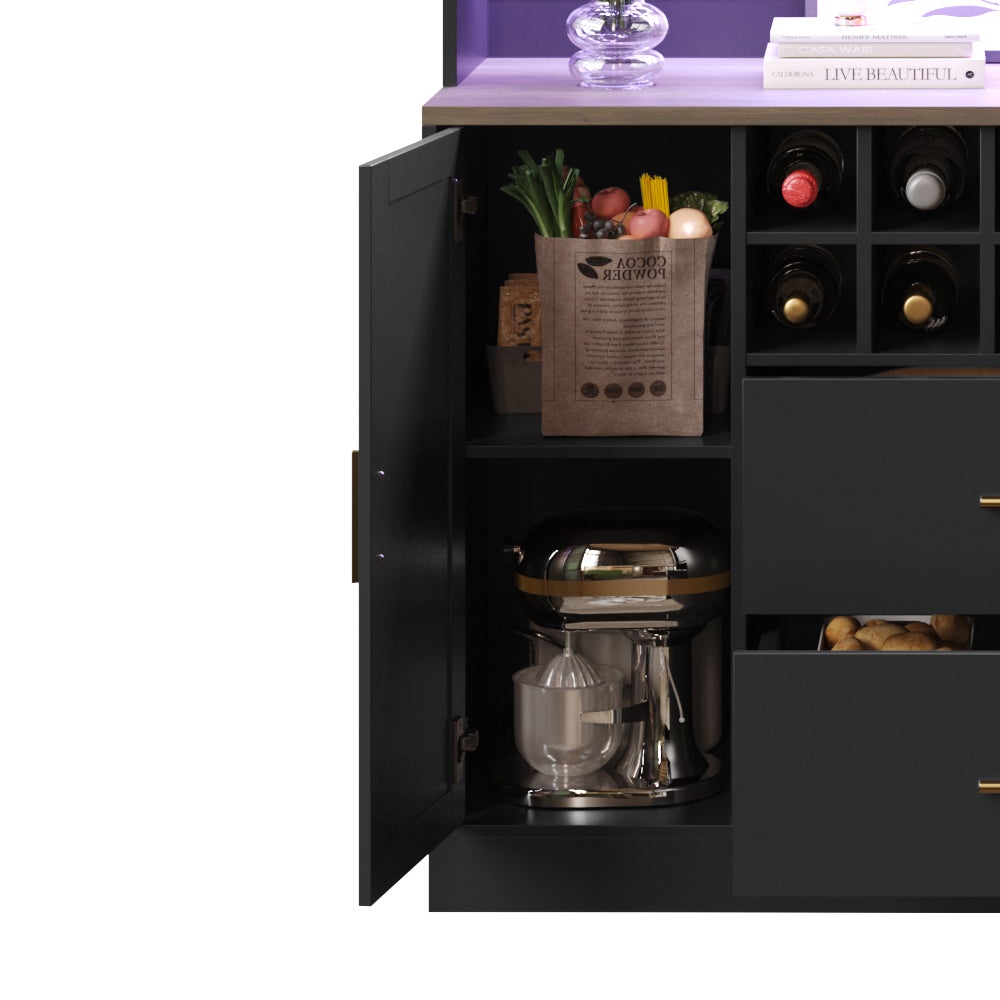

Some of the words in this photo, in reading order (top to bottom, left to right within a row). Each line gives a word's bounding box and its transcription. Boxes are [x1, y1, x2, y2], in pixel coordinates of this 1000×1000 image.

[798, 46, 836, 55] CASA
[838, 46, 873, 55] WABI
[824, 67, 862, 81] LIVE
[866, 67, 958, 81] BEAUTIFUL
